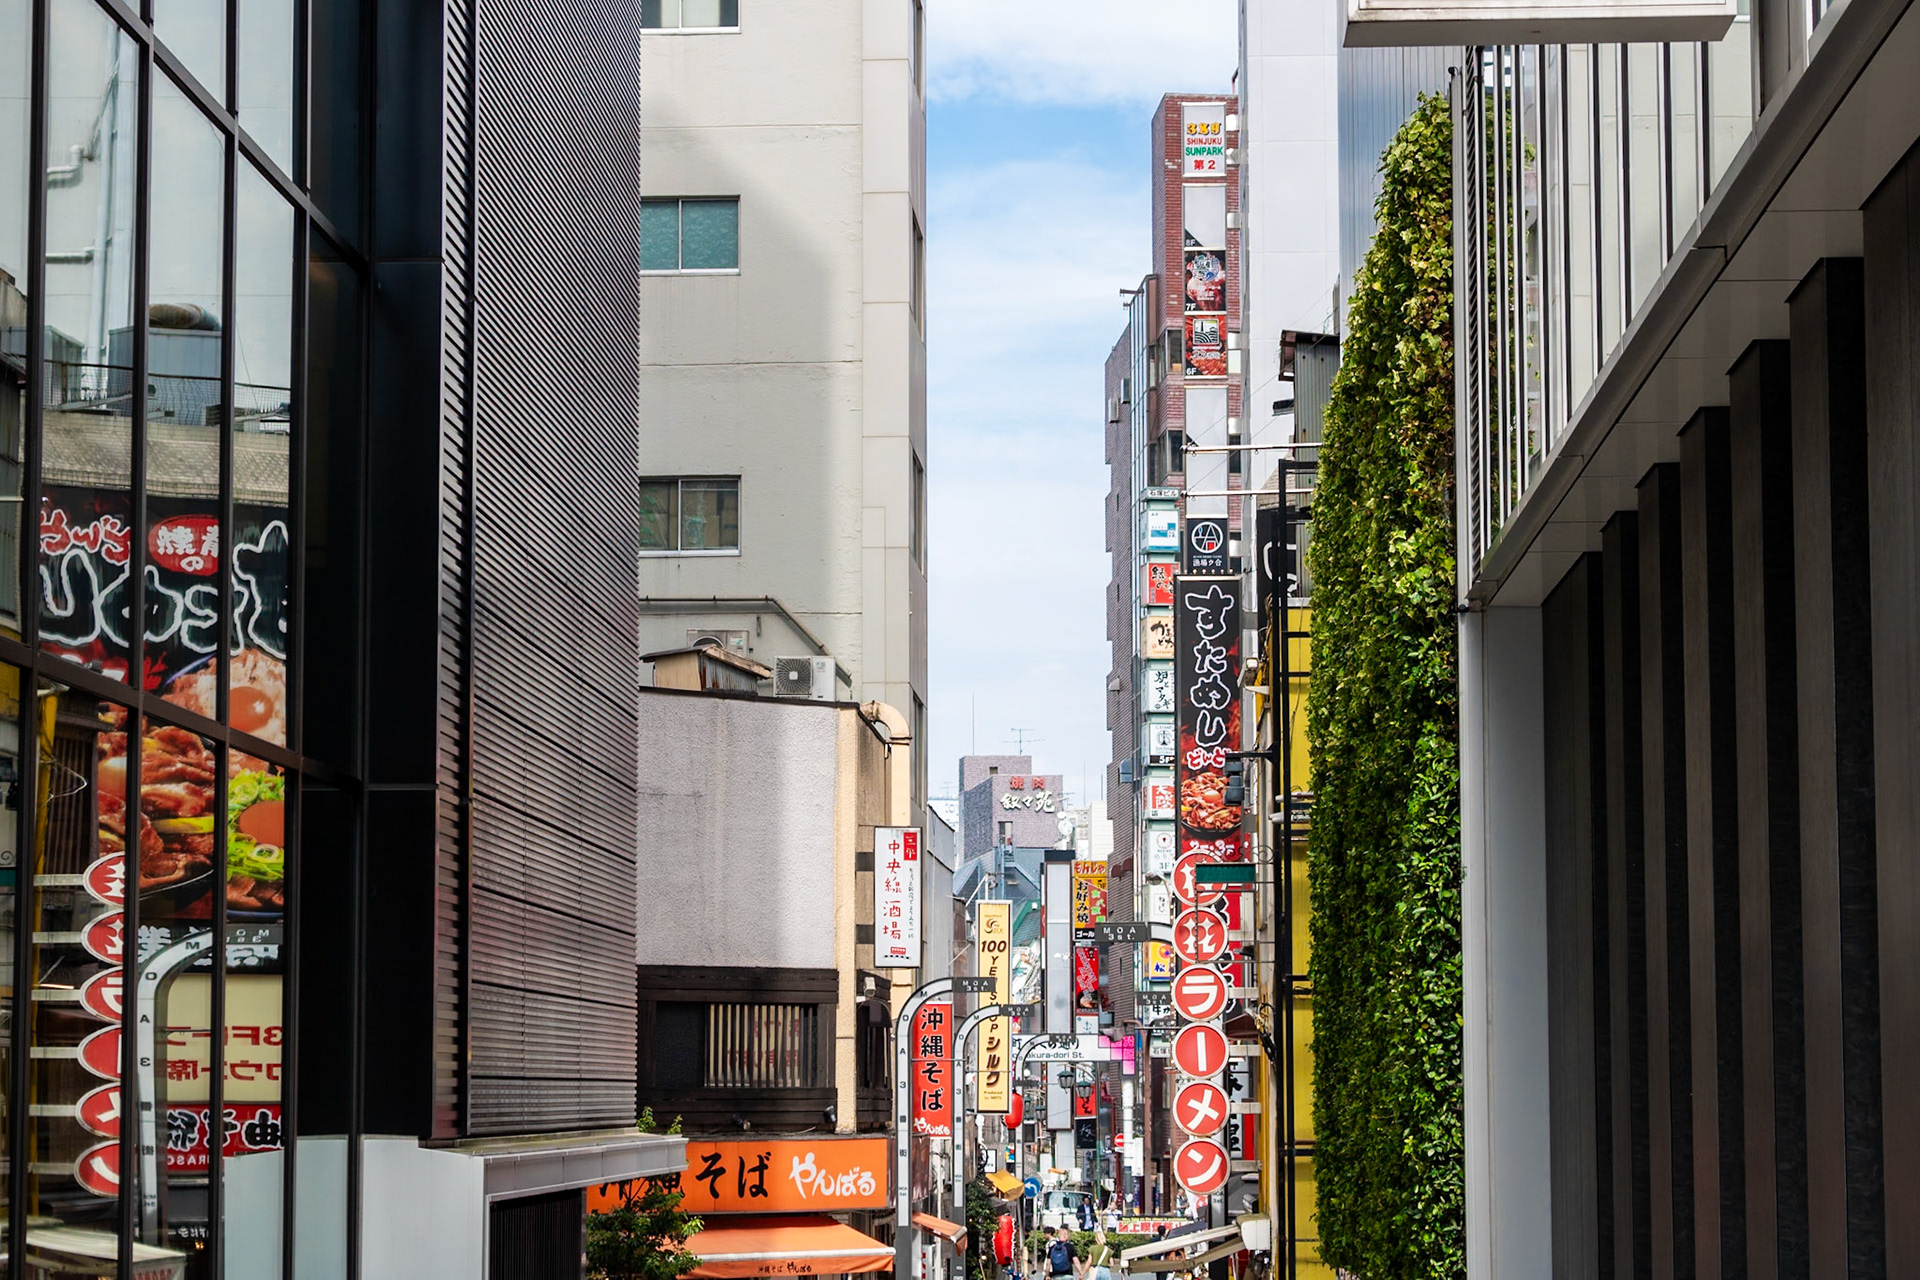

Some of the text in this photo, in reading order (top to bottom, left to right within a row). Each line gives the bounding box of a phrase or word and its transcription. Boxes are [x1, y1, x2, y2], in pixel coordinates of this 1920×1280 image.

[1187, 137, 1222, 146] SHINJUKU
[1185, 146, 1223, 156] SUNPARK
[1185, 303, 1196, 311] 7F
[1186, 367, 1197, 375] 6F
[1009, 776, 1046, 790] 焼肉
[1000, 791, 1056, 813] 叙々苑
[1074, 861, 1106, 875] もんじゃ
[883, 839, 902, 940] 中央線酒場
[981, 940, 1007, 953] 100
[921, 1007, 944, 1111] 沖縄そば
[986, 1036, 1001, 1088] シルク
[1026, 1051, 1070, 1059] akura-dori
[1072, 1051, 1085, 1059] St.
[789, 1152, 876, 1200] やんばる
